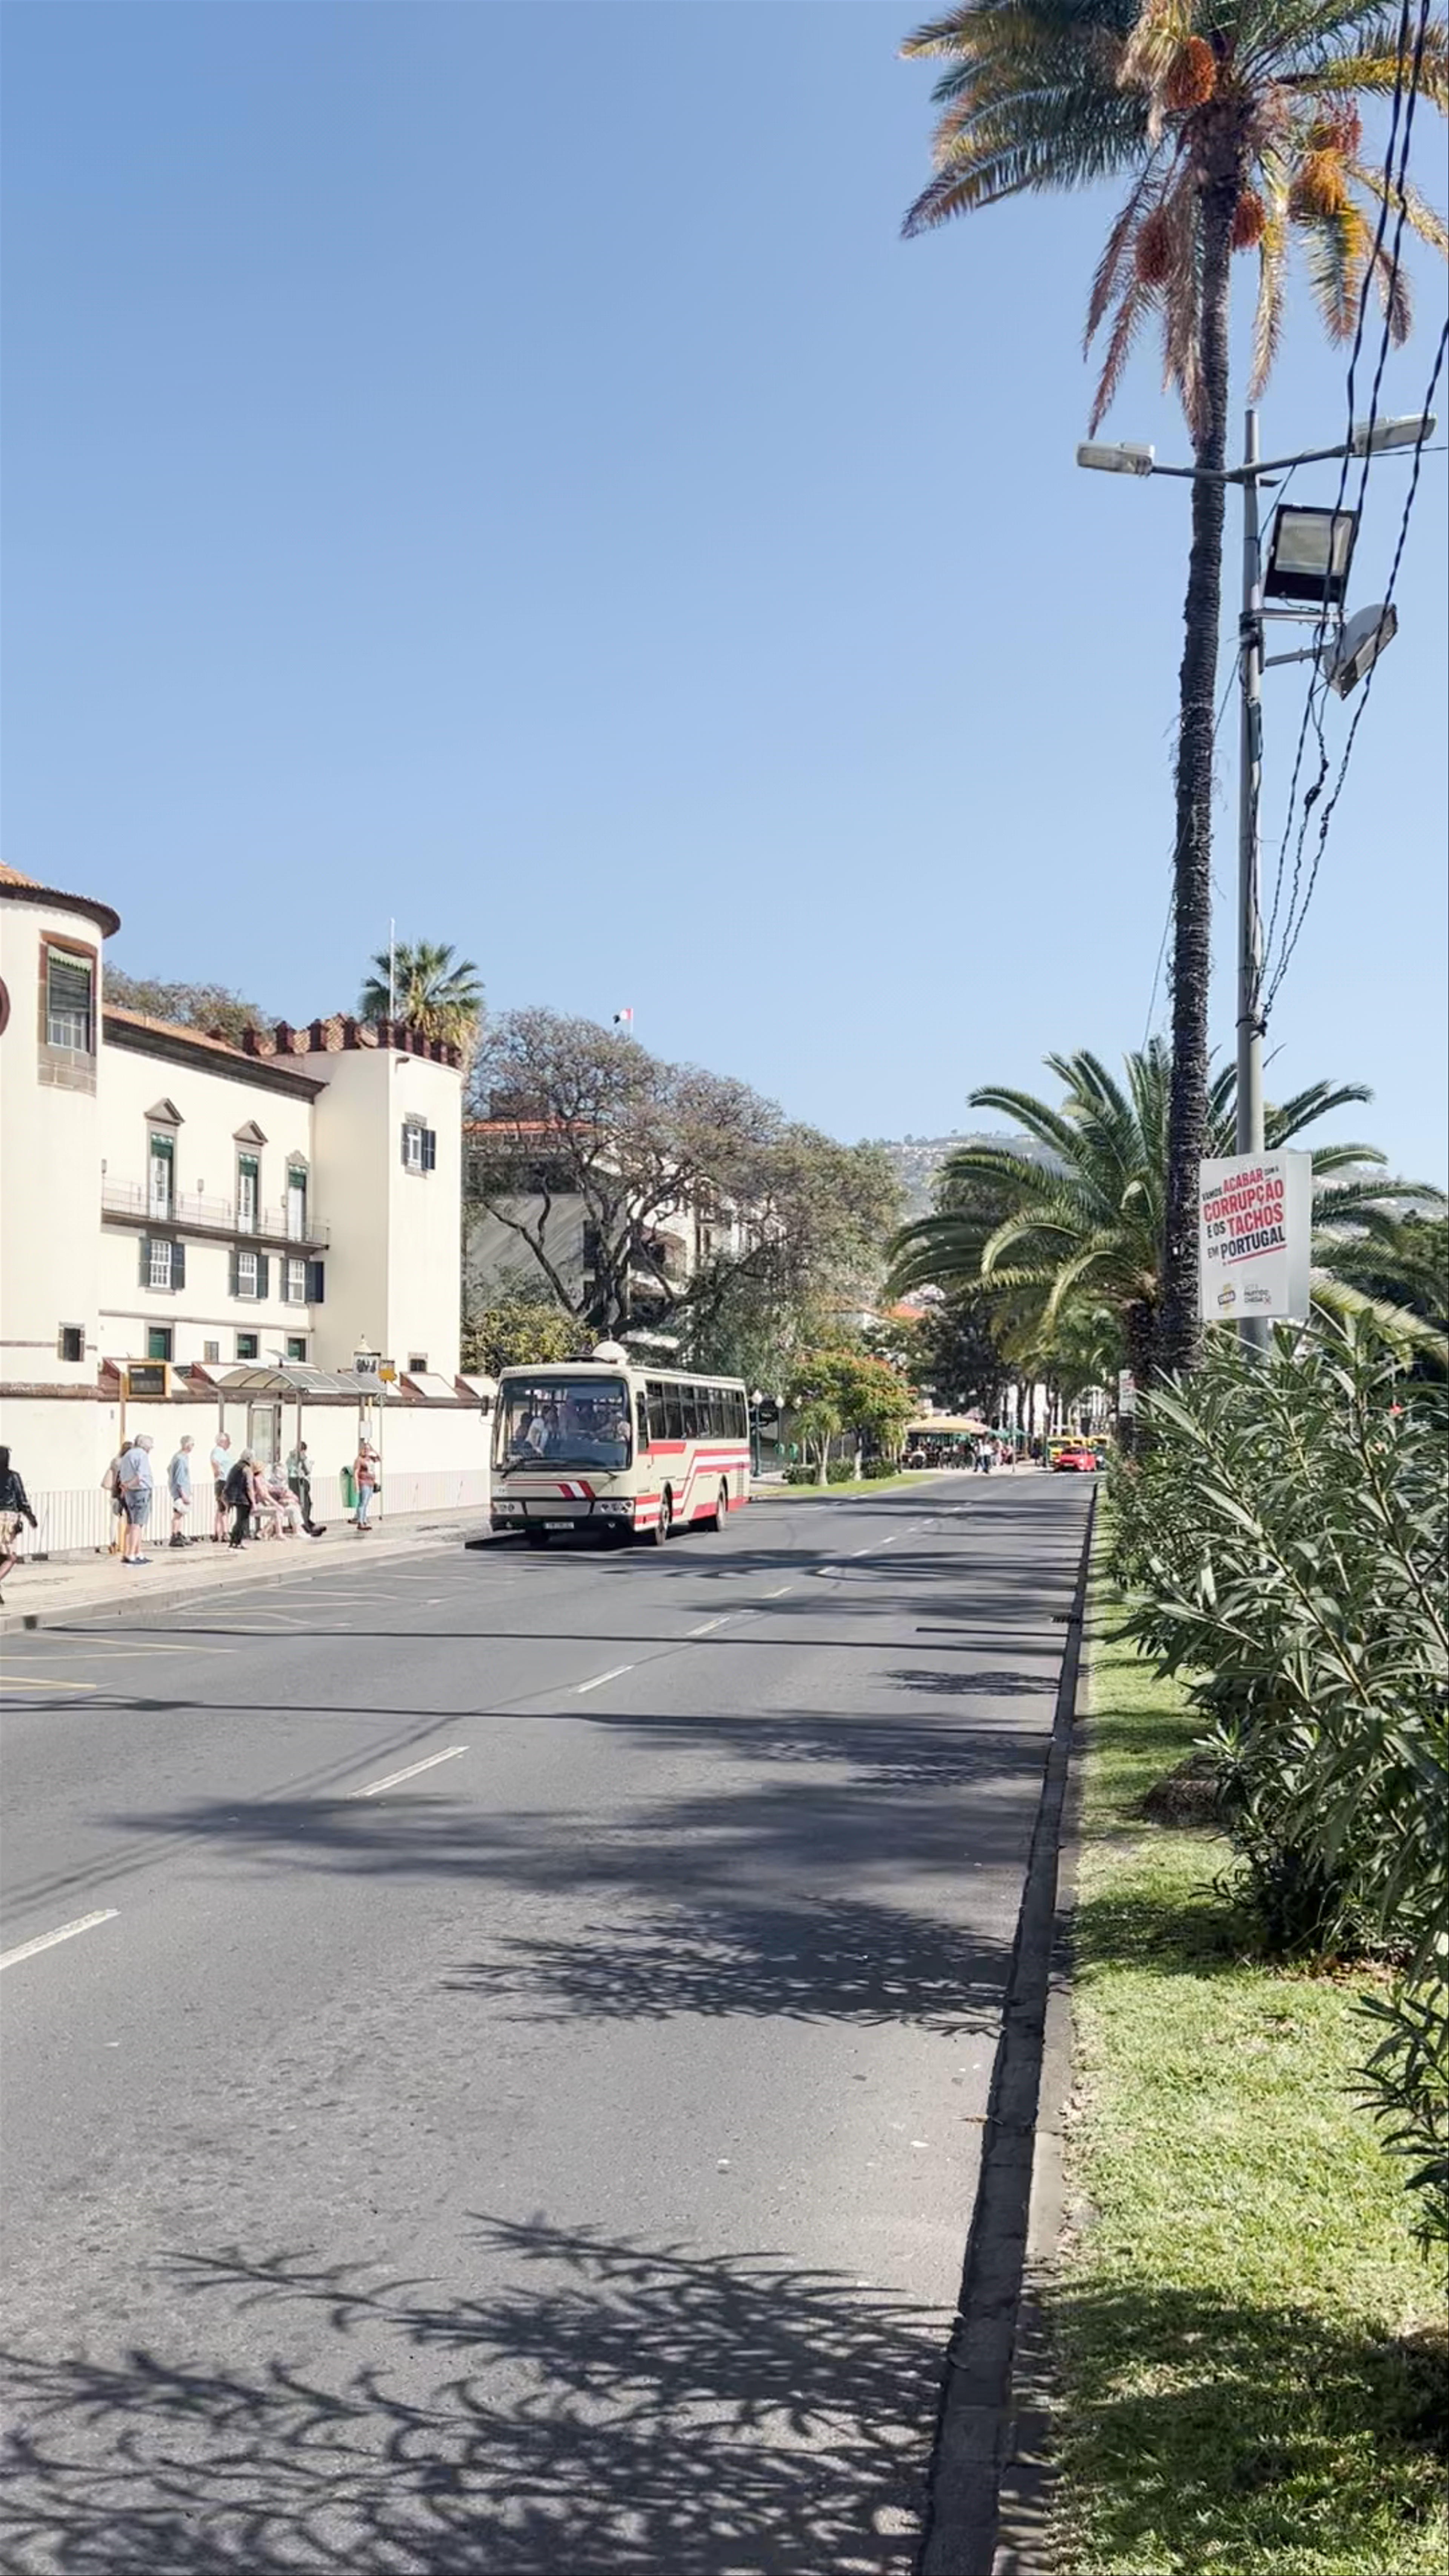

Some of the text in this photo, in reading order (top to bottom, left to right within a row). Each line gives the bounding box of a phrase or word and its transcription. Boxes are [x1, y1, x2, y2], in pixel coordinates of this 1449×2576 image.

[1223, 1167, 1263, 1193] ACABAR
[1204, 1178, 1283, 1222] CORRUPÇÃO
[1207, 1203, 1283, 1238] E OS TACHOS
[1208, 1226, 1286, 1260] EM PORTUGAL
